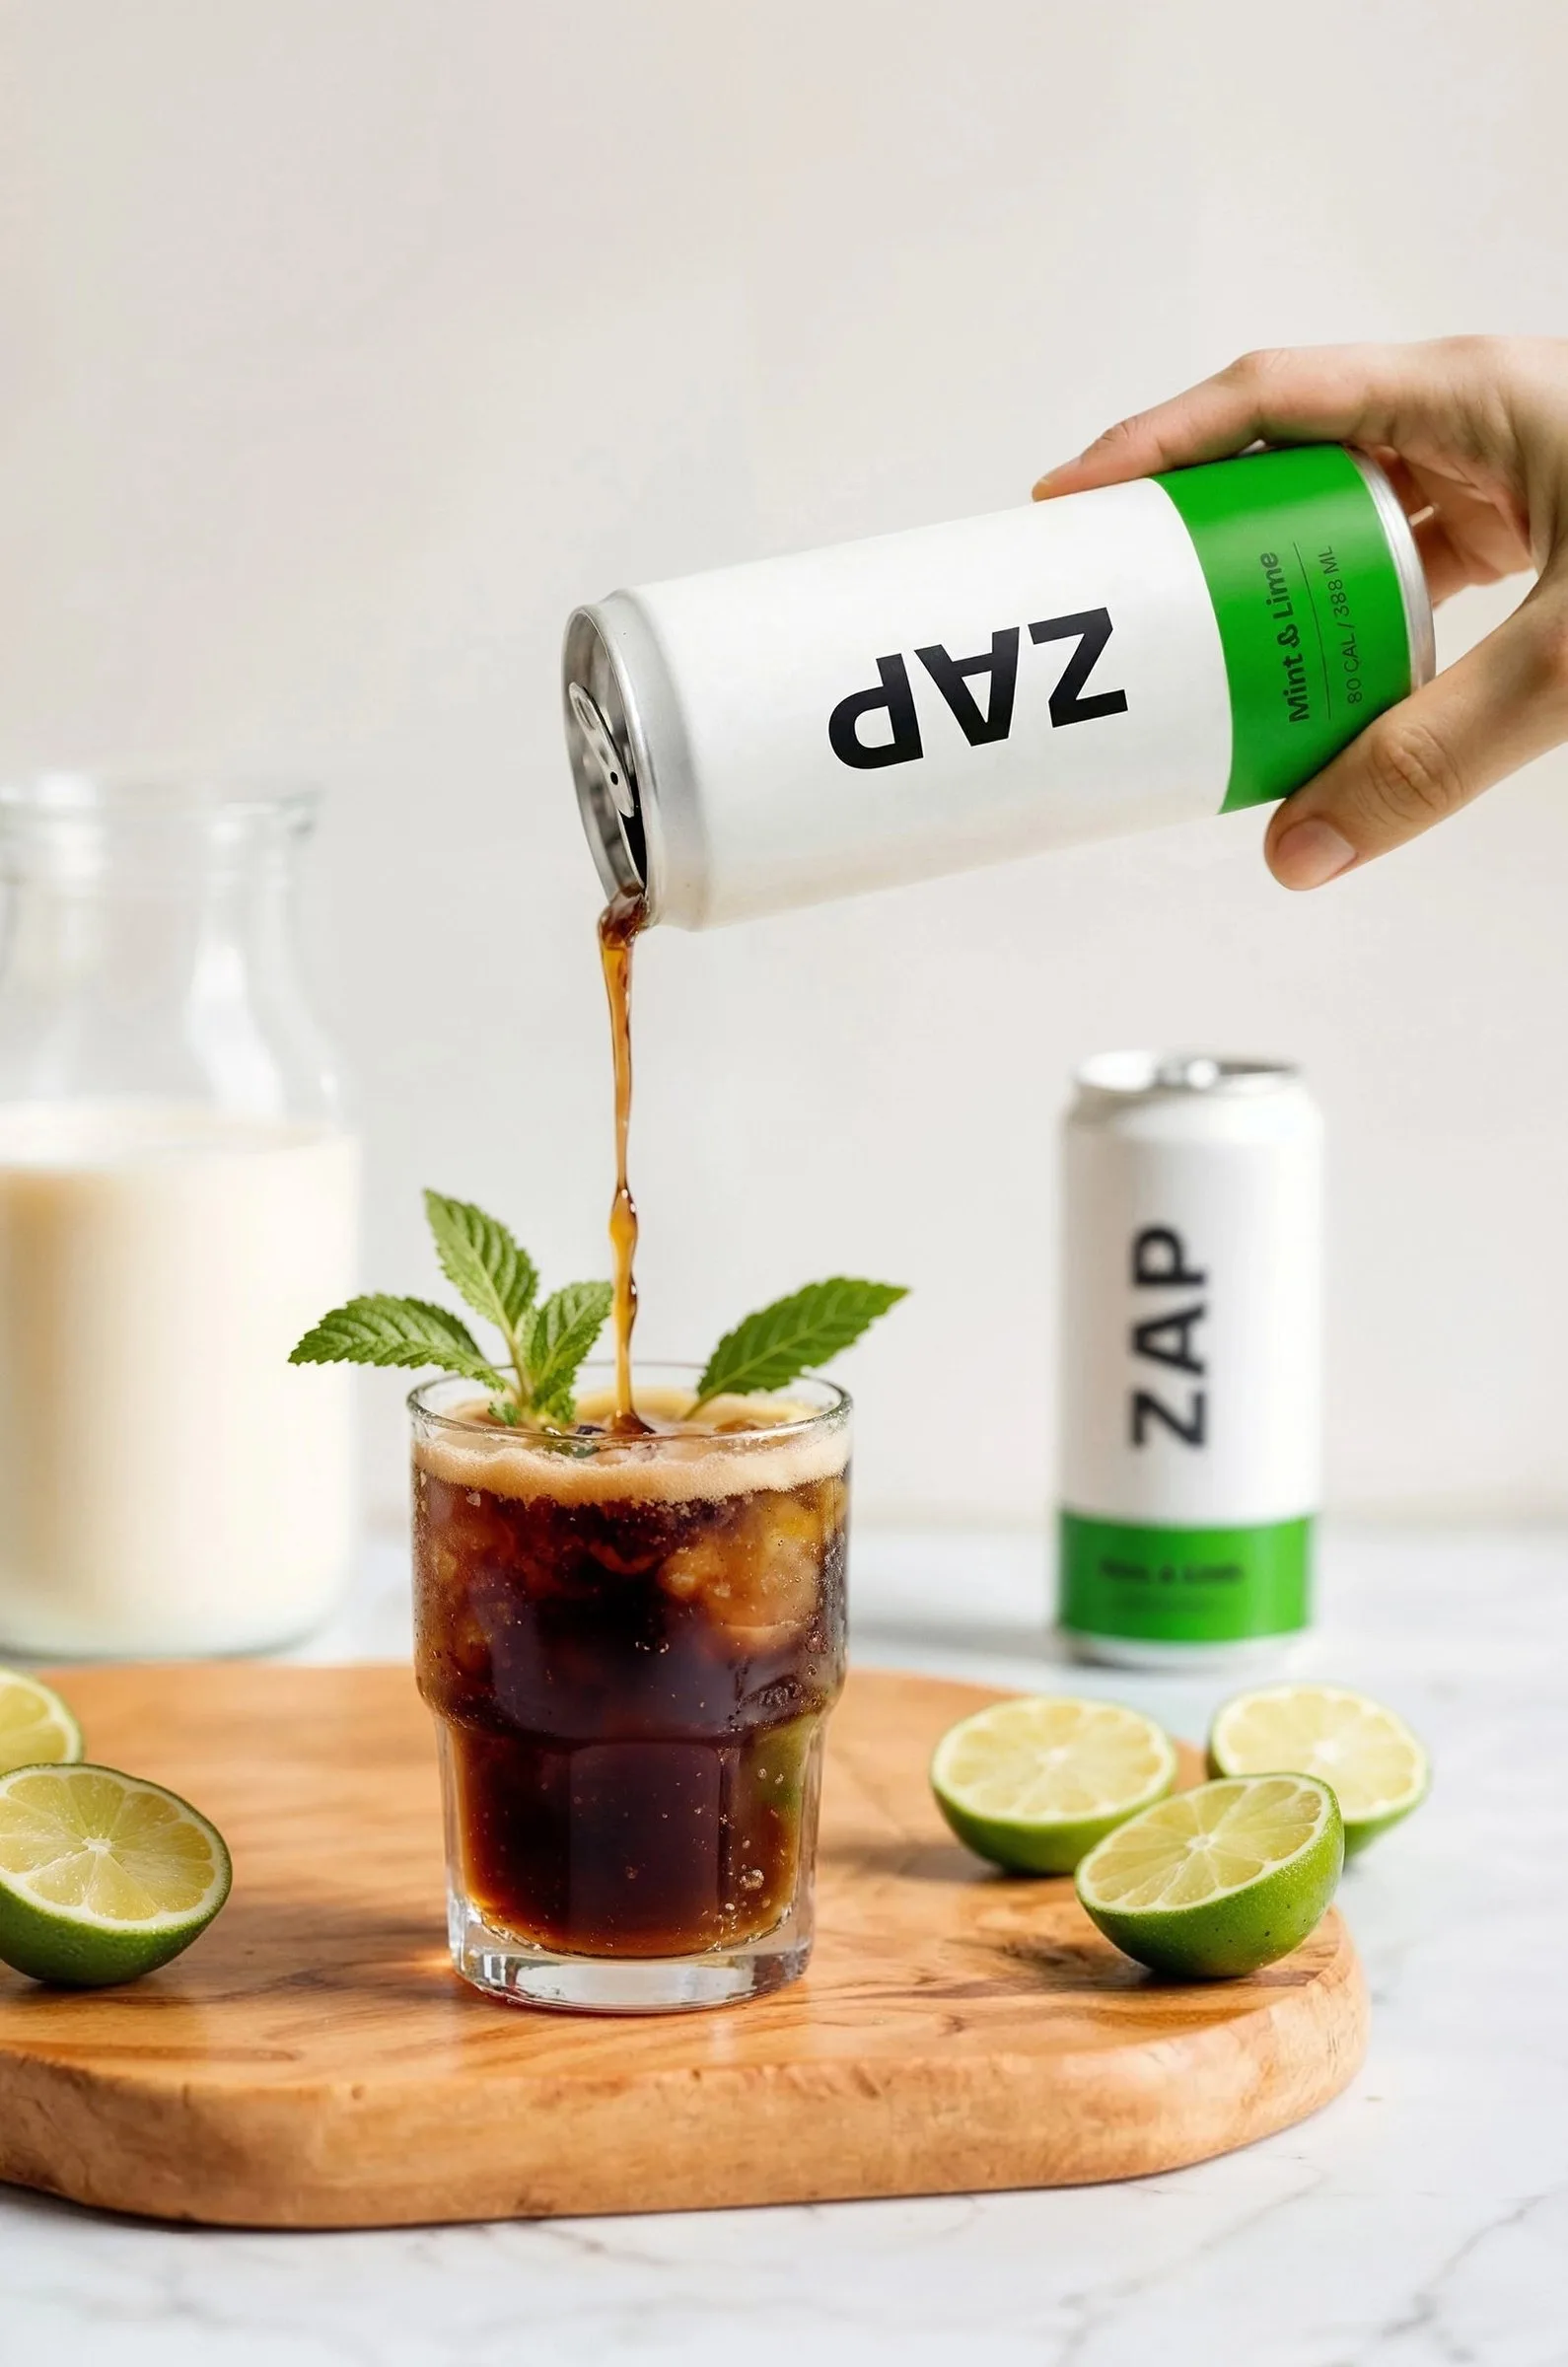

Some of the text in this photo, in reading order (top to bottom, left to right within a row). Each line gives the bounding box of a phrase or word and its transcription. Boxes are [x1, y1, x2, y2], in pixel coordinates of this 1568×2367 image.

[1318, 545, 1339, 575] ML
[1327, 579, 1350, 618] 388
[1260, 552, 1310, 722] Mint & Lime
[1340, 633, 1361, 673] CAL
[827, 607, 1129, 770] ZAP
[1346, 678, 1363, 704] 80
[1129, 1224, 1205, 1448] ZAP
